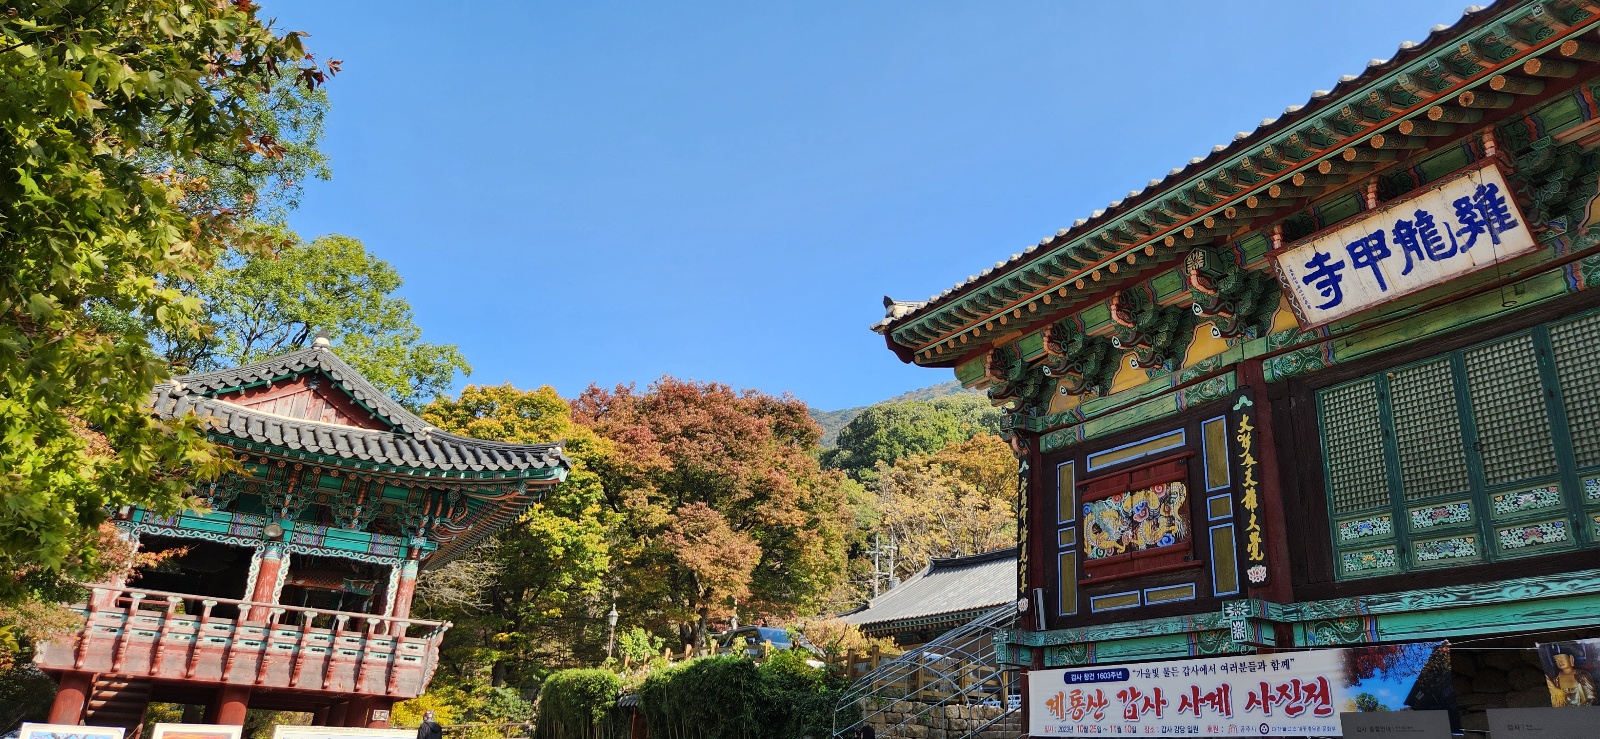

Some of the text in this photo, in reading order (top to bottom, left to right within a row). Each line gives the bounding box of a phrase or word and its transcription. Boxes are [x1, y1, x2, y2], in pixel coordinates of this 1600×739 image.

[1070, 670, 1123, 682] 갑사 창건 1603주년
[1163, 666, 1179, 678] 물든
[1182, 663, 1216, 677] 갑사에서
[1220, 659, 1267, 674] 여러분들과
[1045, 675, 1333, 720] 계룡산 갑사 사계 사진전
[1144, 725, 1155, 734] 장소
[1161, 725, 1172, 734] 갑사
[1187, 725, 1199, 734] 일원
[1207, 724, 1219, 734] 후원
[1240, 725, 1257, 733] 공주시
